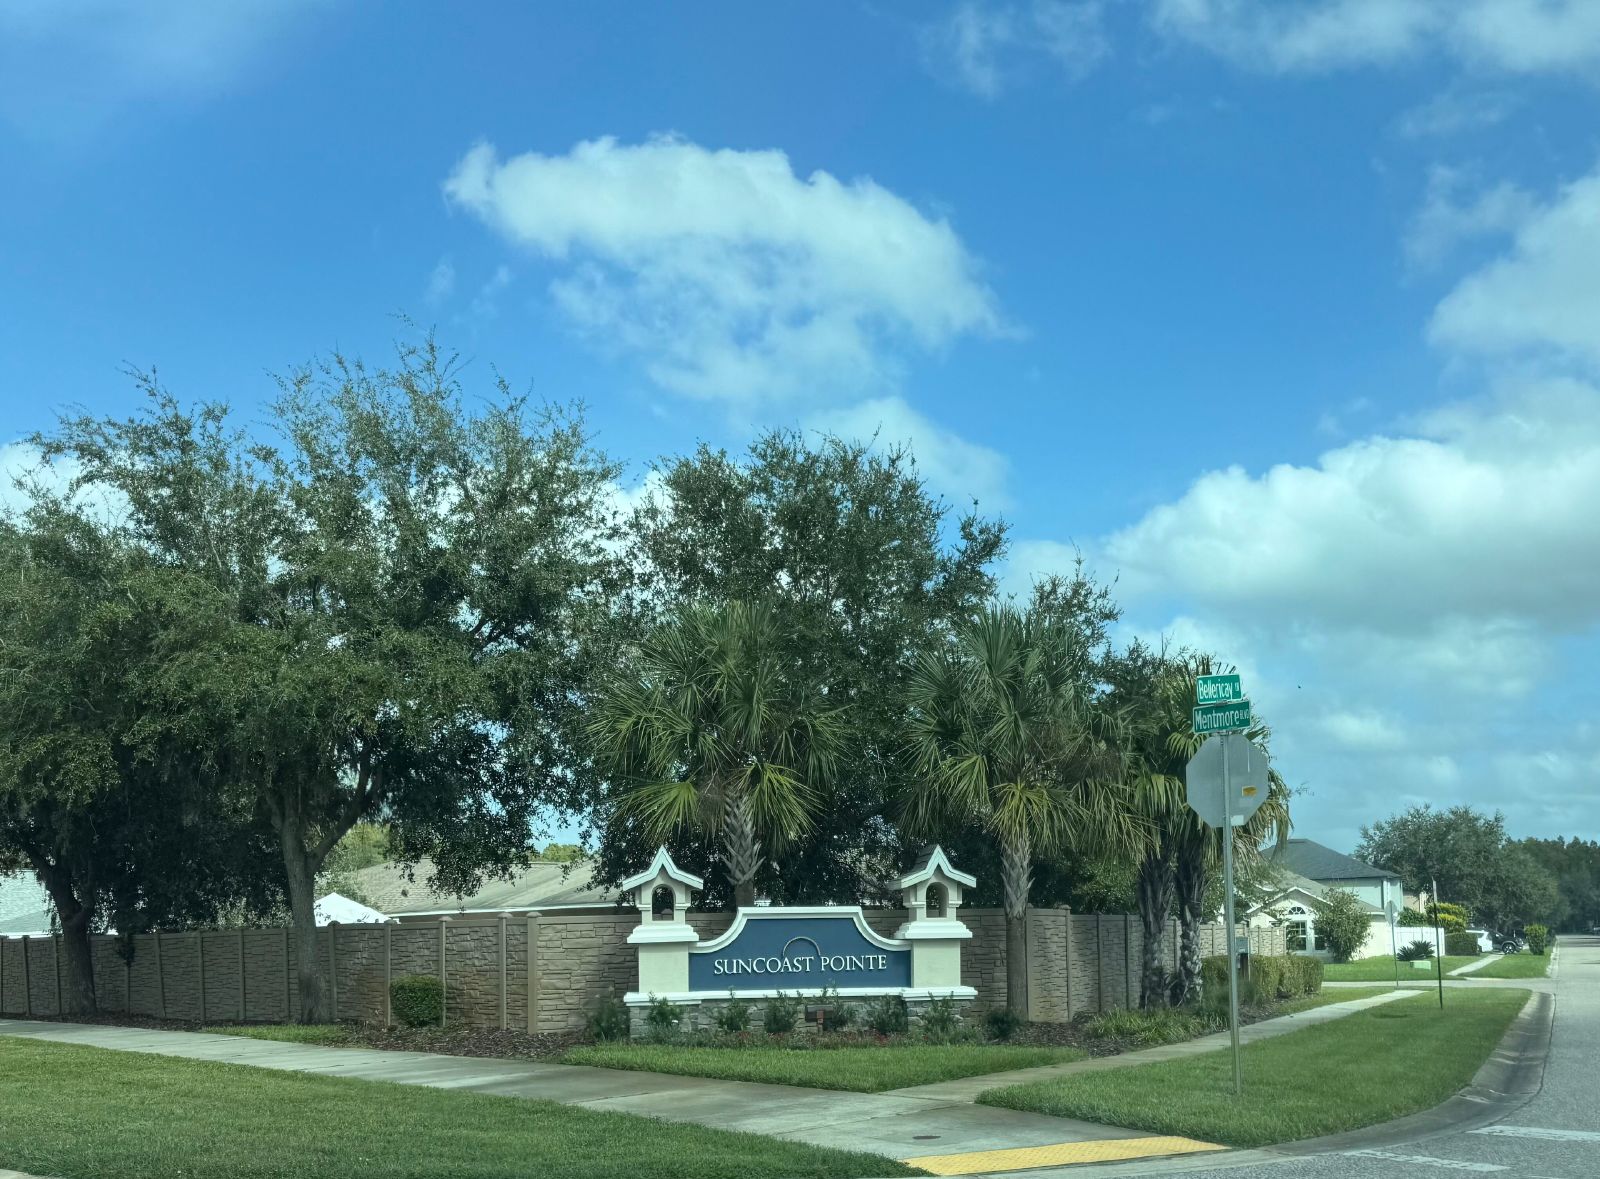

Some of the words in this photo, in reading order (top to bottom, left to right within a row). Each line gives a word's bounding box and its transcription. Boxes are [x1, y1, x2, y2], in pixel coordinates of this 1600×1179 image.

[1195, 710, 1240, 730] Mentmore
[714, 956, 814, 975] SUNCOAST
[820, 954, 887, 972] POINTE
